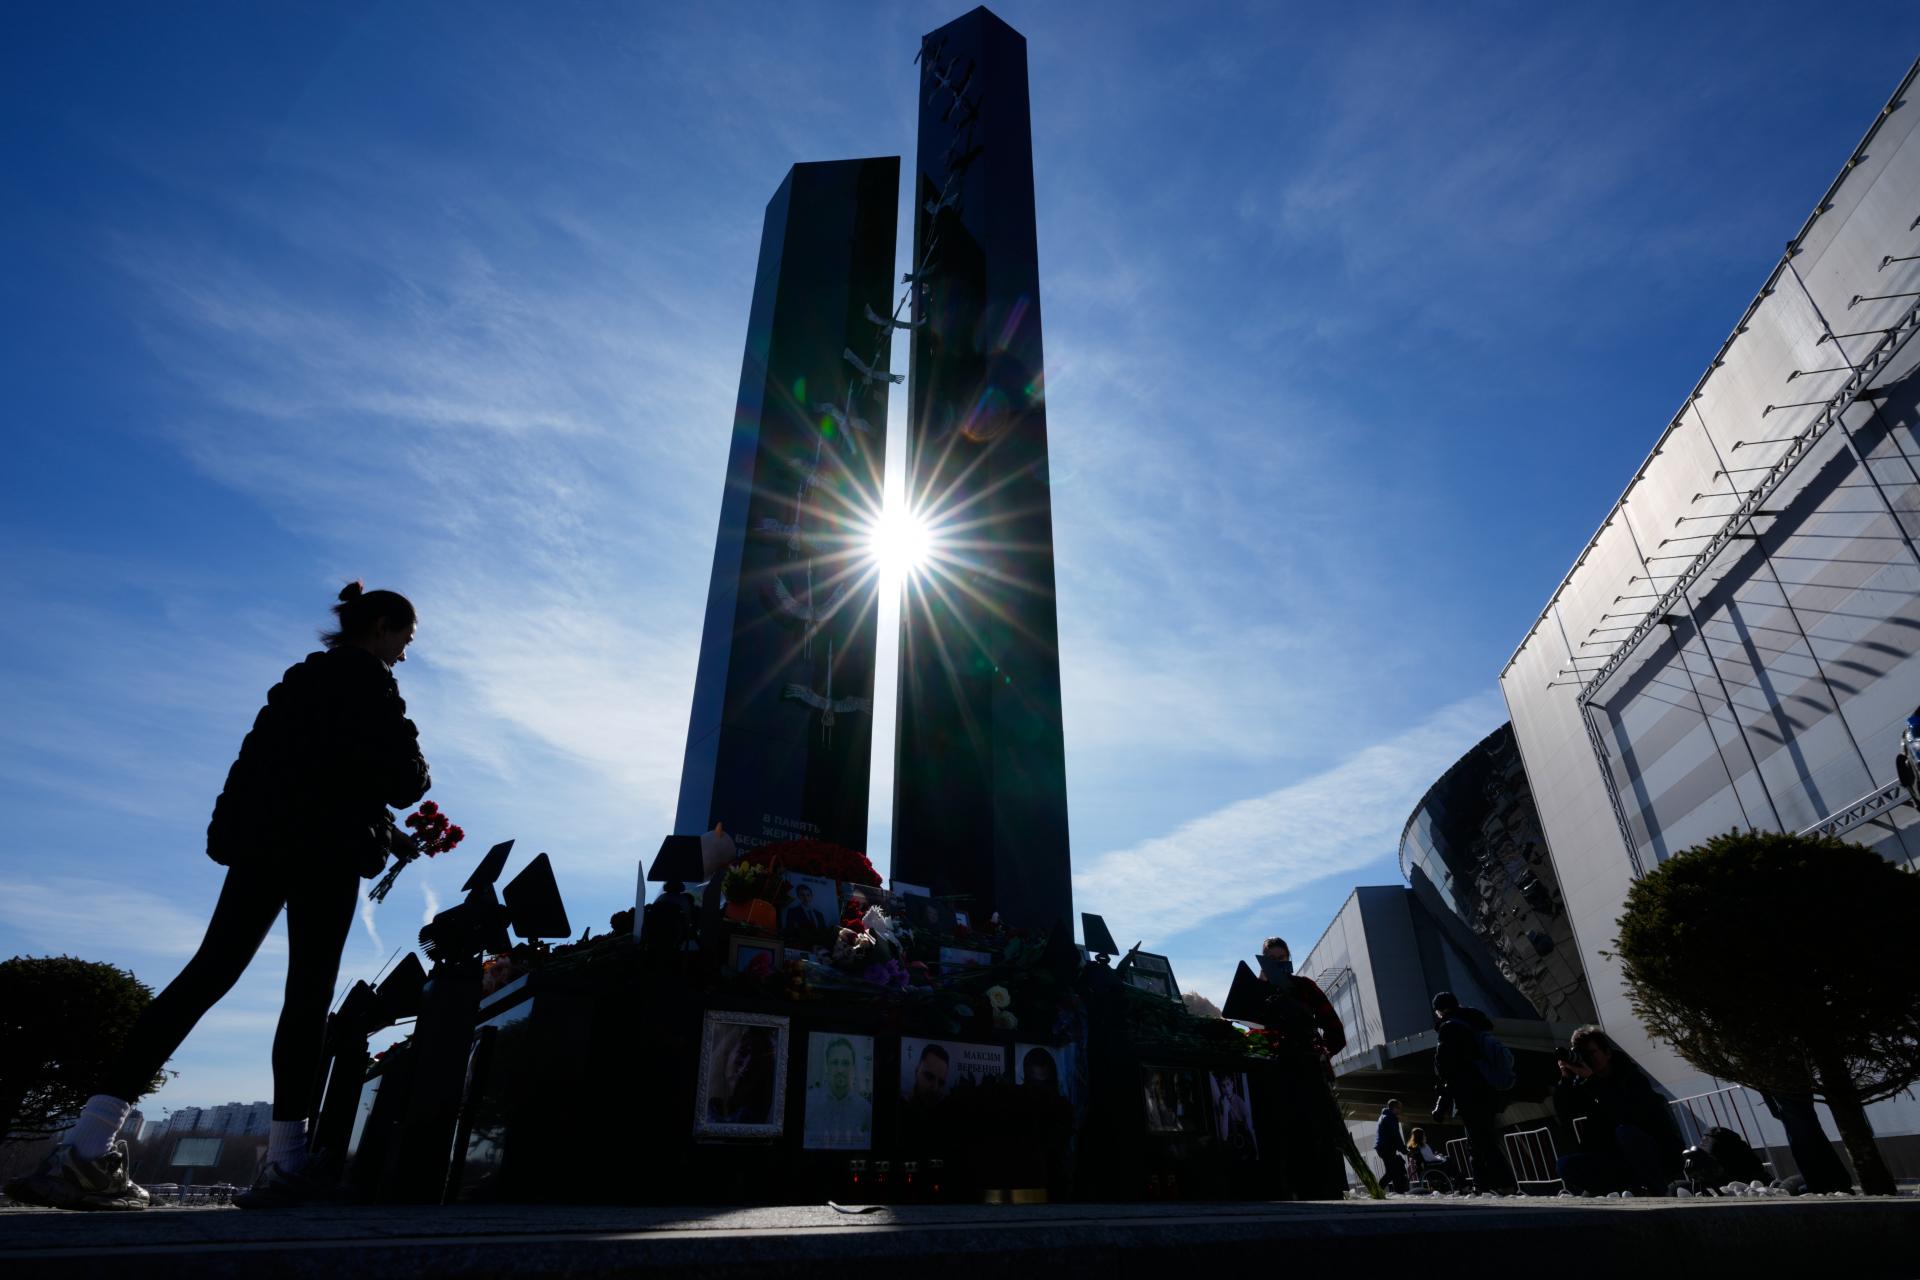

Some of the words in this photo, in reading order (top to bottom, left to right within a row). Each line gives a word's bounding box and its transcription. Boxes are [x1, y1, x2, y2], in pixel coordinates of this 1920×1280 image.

[762, 814, 771, 823] В
[774, 816, 821, 834] ПАМЯТЬ
[762, 825, 820, 841] ЖЕРТВ
[963, 1050, 1001, 1062] МАКСИМ
